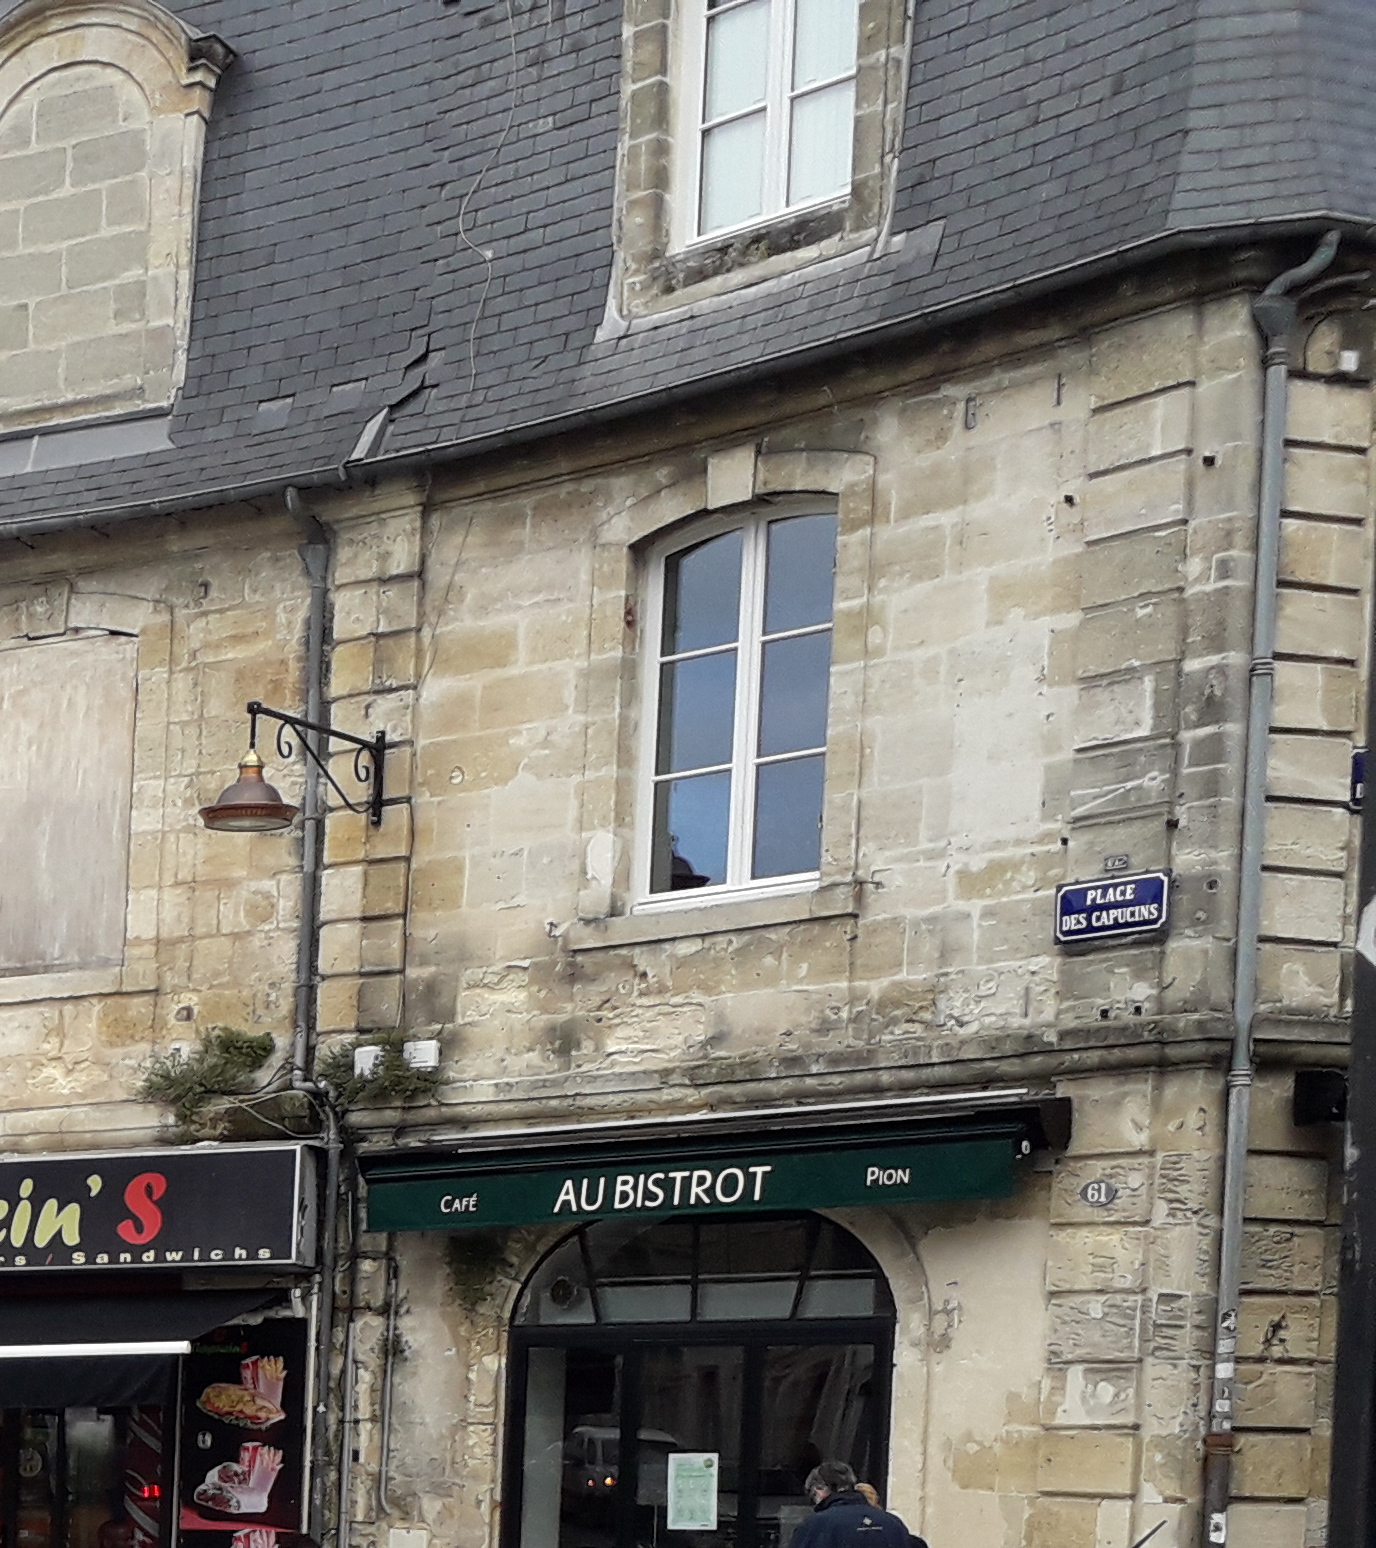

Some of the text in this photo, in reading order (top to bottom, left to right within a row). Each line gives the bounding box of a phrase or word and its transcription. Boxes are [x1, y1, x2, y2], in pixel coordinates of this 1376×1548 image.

[1086, 884, 1135, 906] PLACE
[1062, 903, 1158, 931] DES CAPUCINS
[553, 1177, 606, 1213] AU
[614, 1165, 772, 1209] BISTROT
[1087, 1182, 1107, 1202] 61
[71, 1247, 271, 1265] Sandwichs
